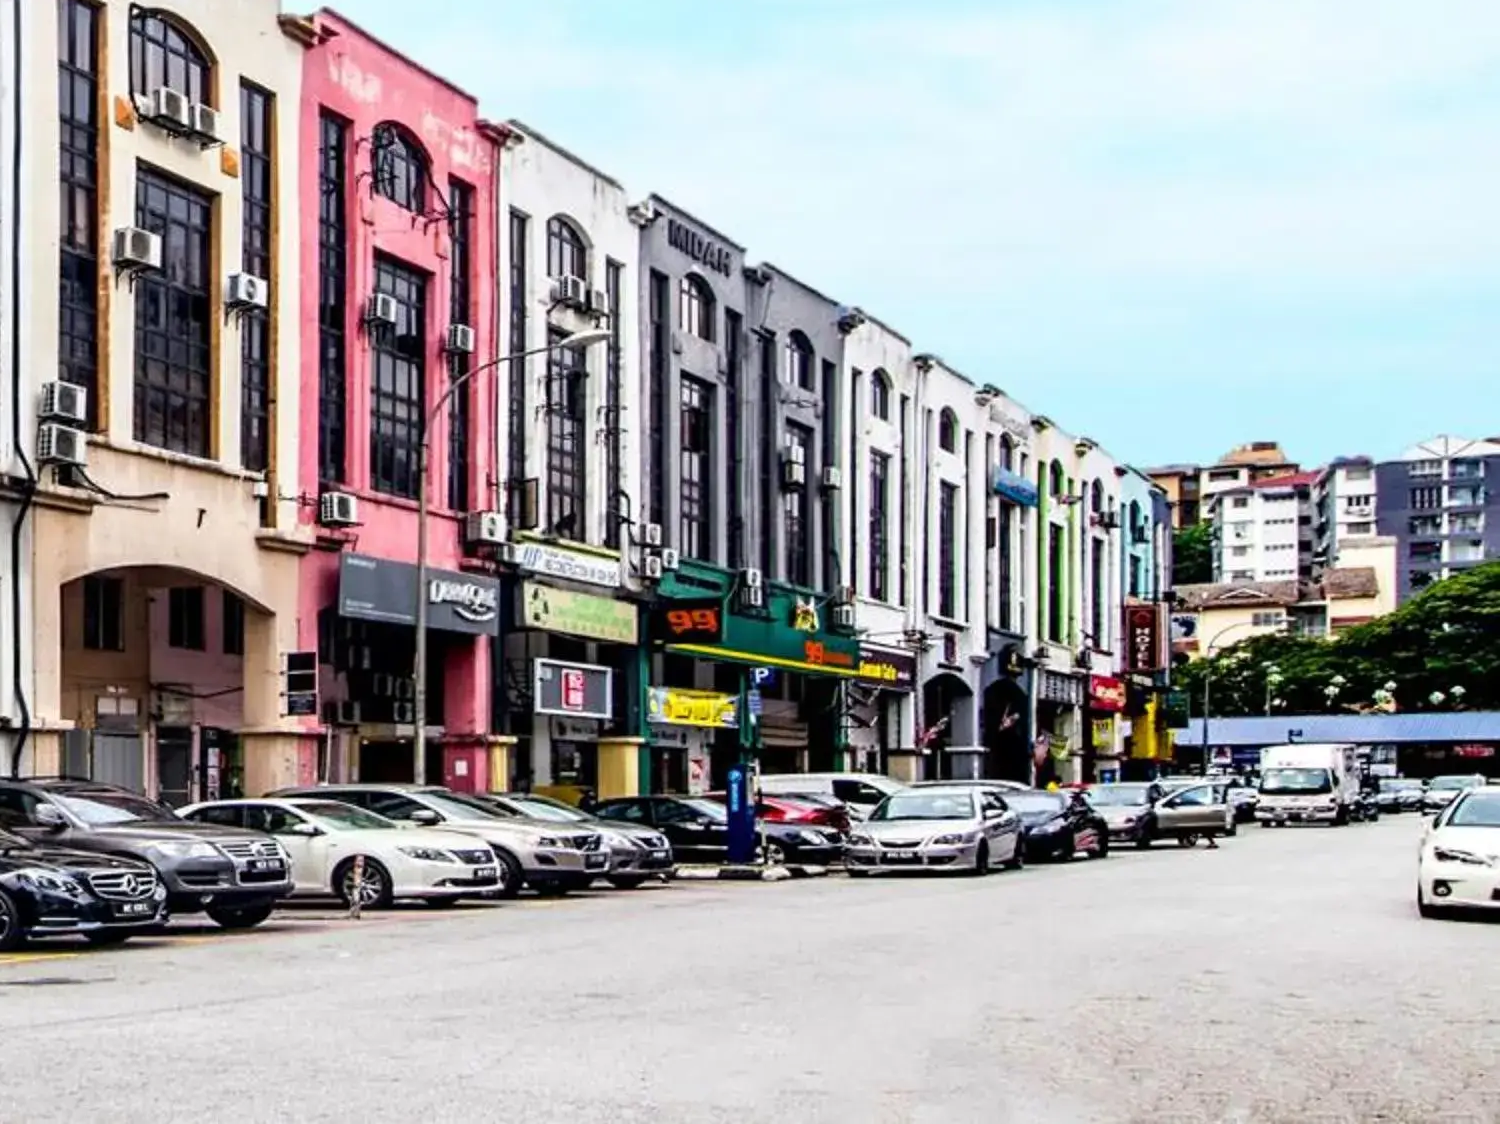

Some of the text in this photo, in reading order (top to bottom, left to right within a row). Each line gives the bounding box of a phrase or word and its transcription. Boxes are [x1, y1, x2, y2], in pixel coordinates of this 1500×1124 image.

[667, 610, 717, 634] 99
[1135, 627, 1151, 669] HOTEL
[755, 667, 769, 683] P
